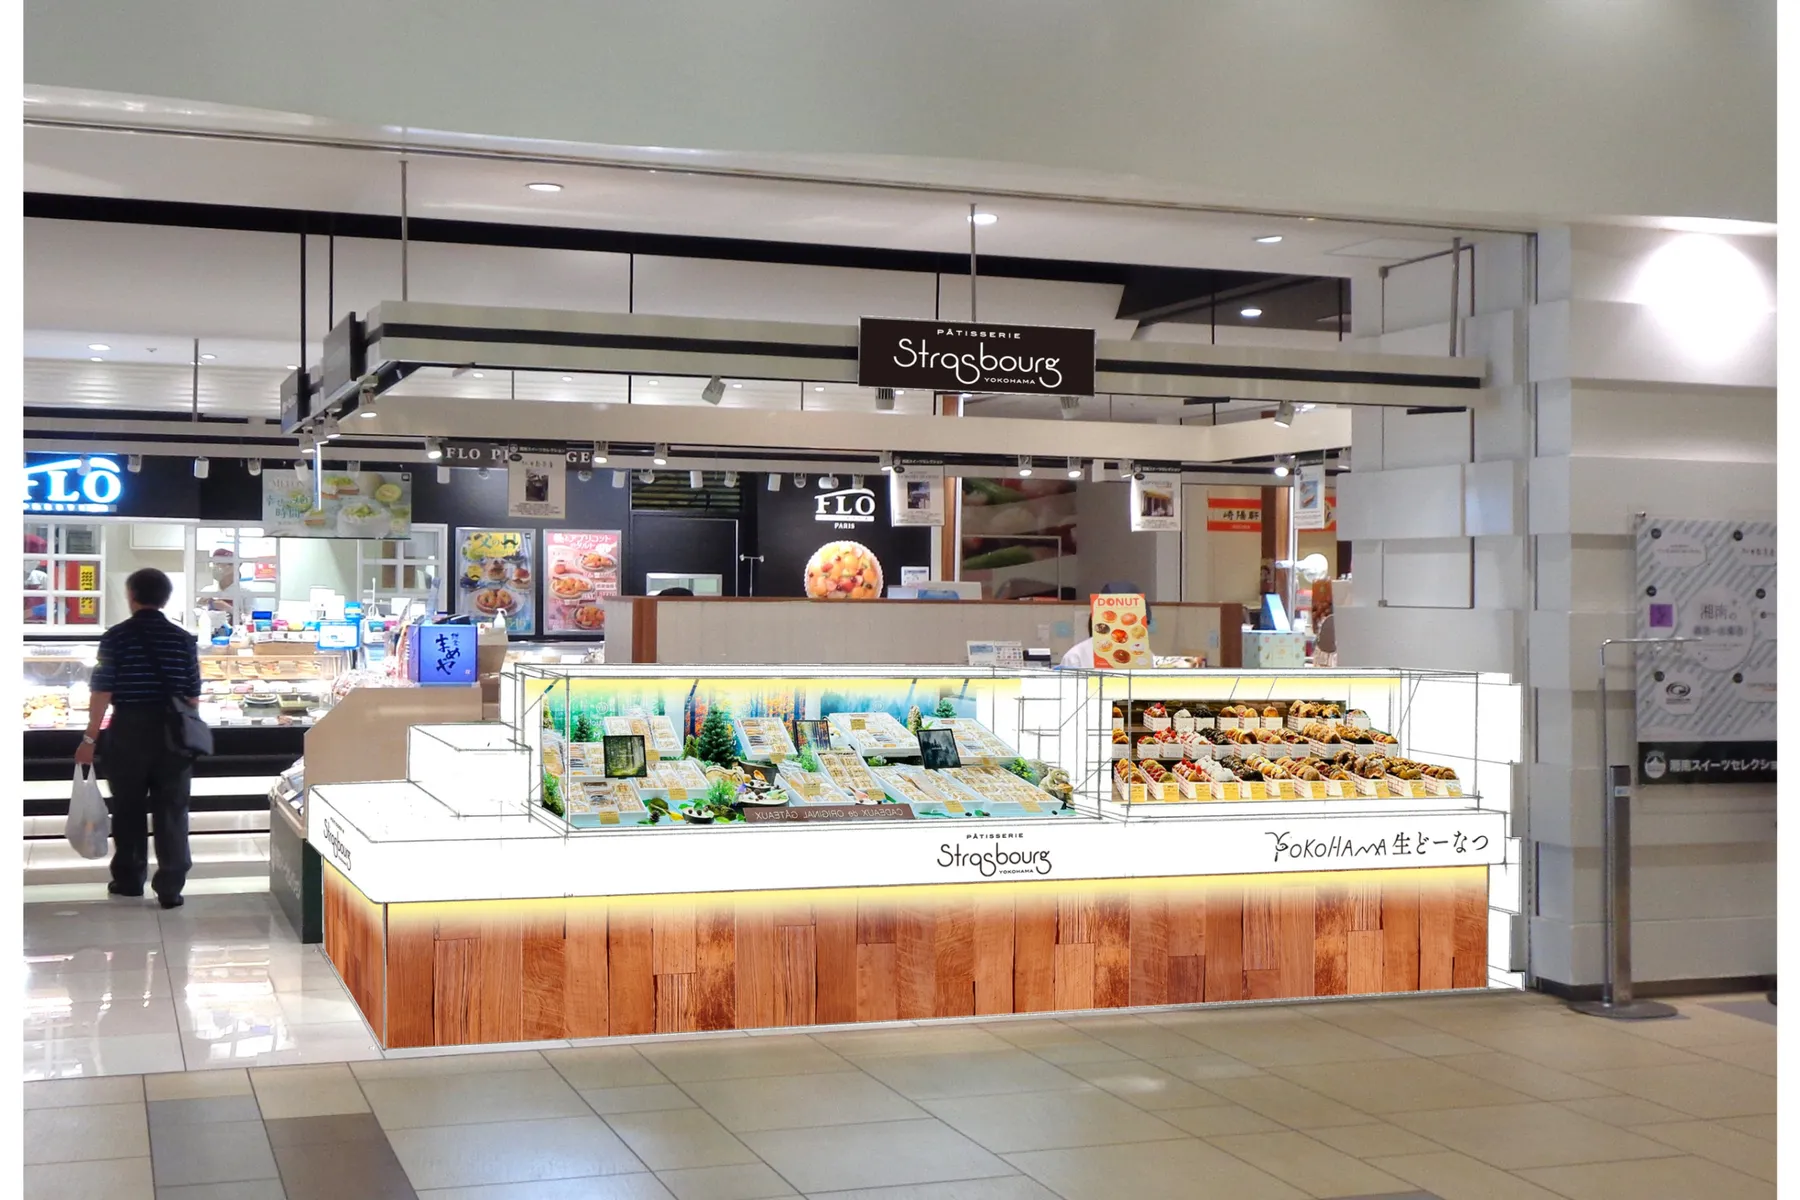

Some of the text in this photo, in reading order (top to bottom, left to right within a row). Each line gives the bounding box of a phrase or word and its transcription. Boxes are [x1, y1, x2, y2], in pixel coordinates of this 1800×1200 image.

[936, 328, 1021, 340] PÂTISSERIE
[893, 338, 1063, 388] Strasbourg
[984, 377, 1036, 385] YOKOHAMA
[446, 447, 481, 460] FLO
[814, 489, 876, 516] FLO
[834, 522, 855, 530] PARIS
[1097, 597, 1140, 608] DONUT
[1264, 830, 1490, 862] YOKOHAMA 生どーなつ
[937, 842, 1052, 877] Strasbourg
